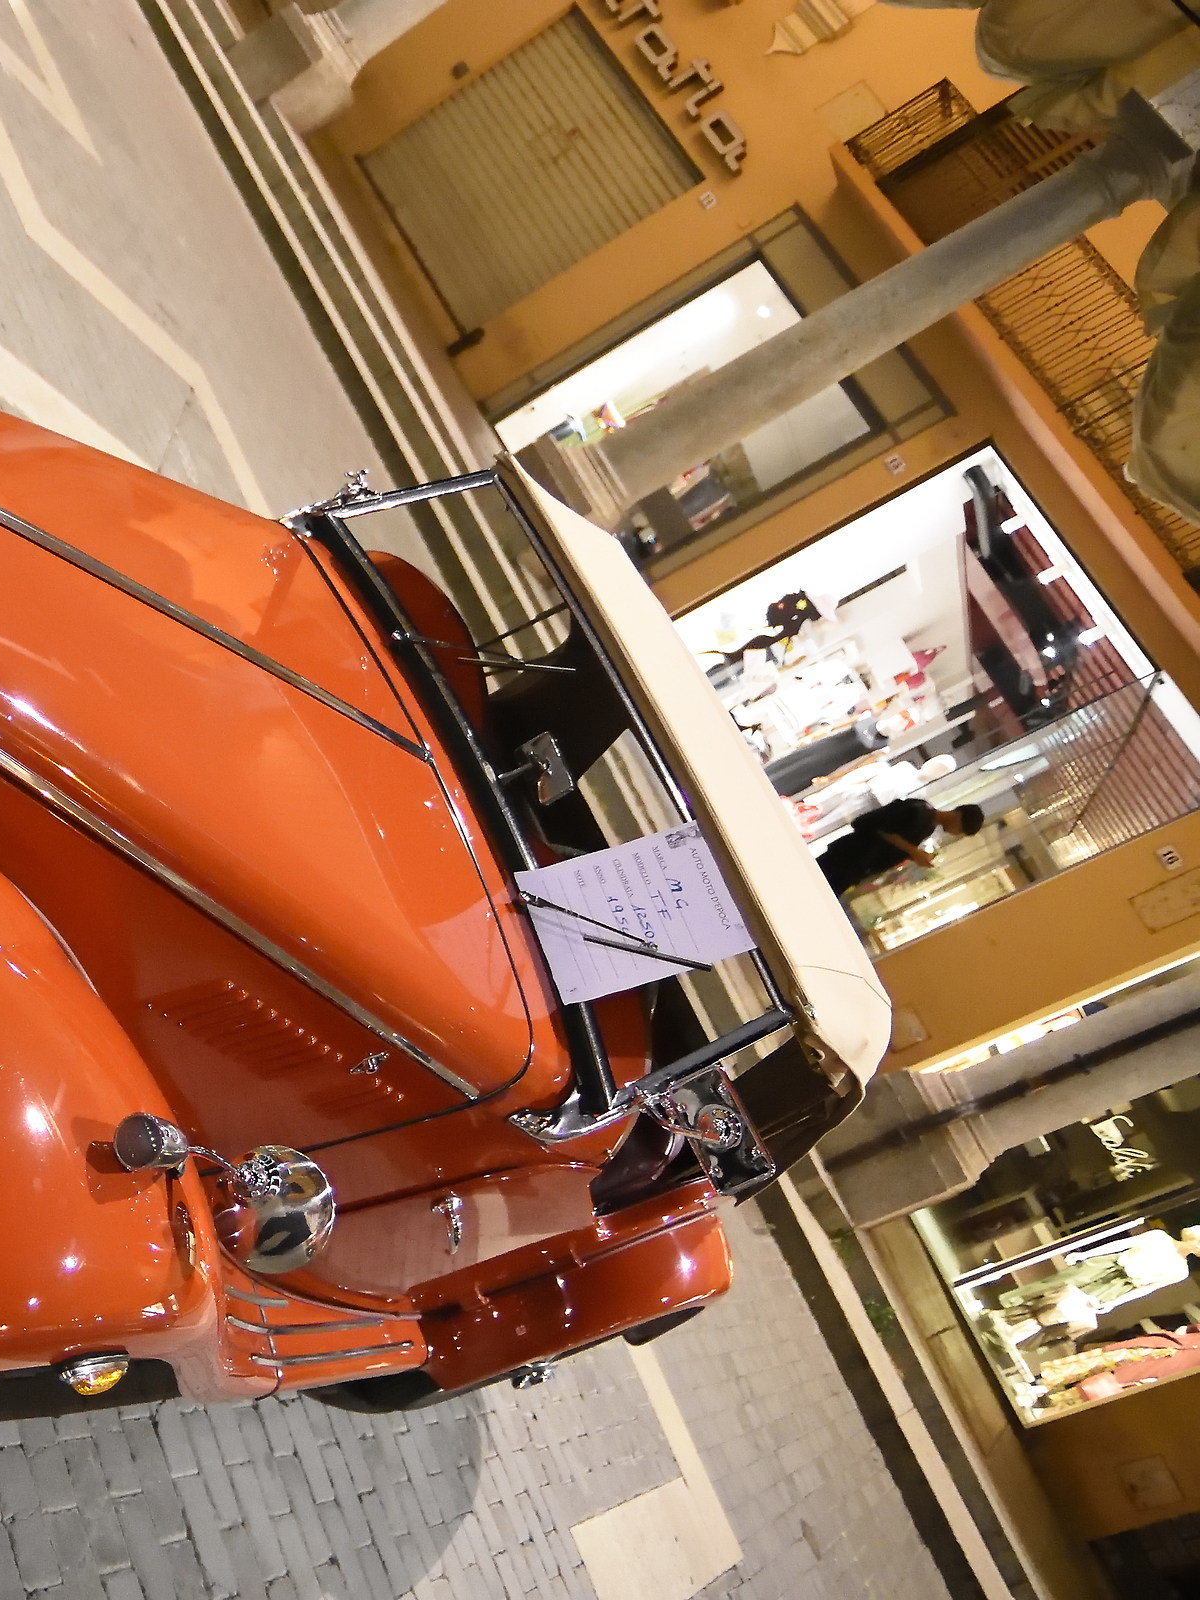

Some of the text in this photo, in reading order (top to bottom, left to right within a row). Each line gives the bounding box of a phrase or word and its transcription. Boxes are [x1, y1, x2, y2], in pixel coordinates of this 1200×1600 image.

[632, 852, 652, 885] MODELLO
[652, 846, 668, 871] MARCA
[1163, 850, 1179, 865] 16
[593, 865, 606, 885] ANNO
[689, 847, 732, 931] AUTO MOTO D'EPOCA
